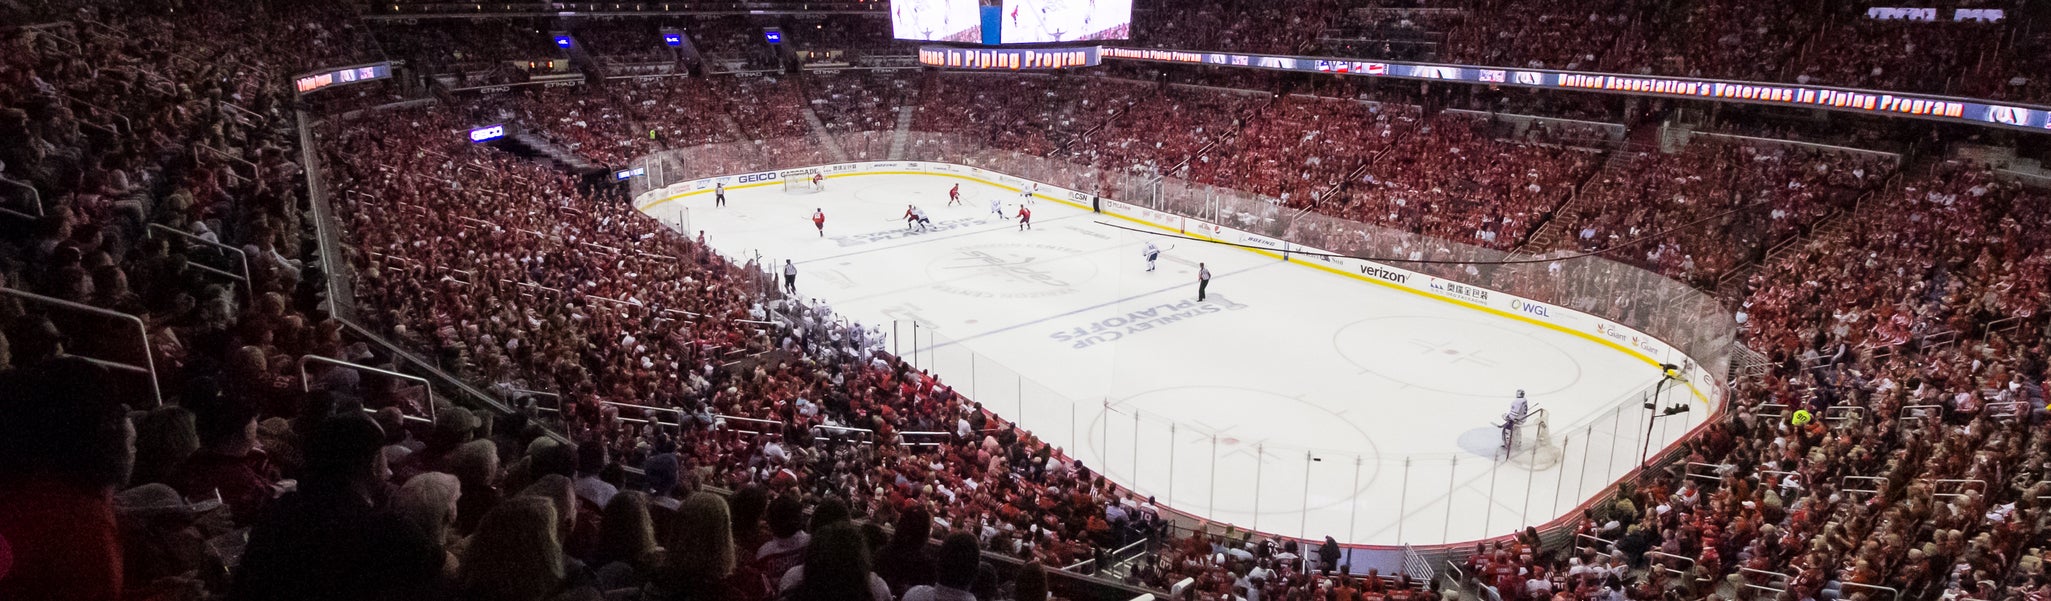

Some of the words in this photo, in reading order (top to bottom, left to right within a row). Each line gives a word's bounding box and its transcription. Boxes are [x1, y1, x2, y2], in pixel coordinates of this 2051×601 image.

[965, 50, 1020, 70] Piping
[1025, 50, 1087, 69] Program
[1558, 73, 1604, 89] United
[1606, 76, 1711, 96] Association's
[1715, 83, 1794, 102] Veterans
[1818, 90, 1877, 110] Piping
[1879, 95, 1964, 118] Program
[471, 126, 502, 141] GEICO
[739, 172, 777, 184] GEICO
[1075, 193, 1088, 201] CSN
[1248, 236, 1275, 247] BOEING
[1360, 264, 1405, 284] verizon
[1127, 303, 1221, 335] STANLEY
[1523, 302, 1550, 318] WGL
[1050, 299, 1194, 342] PLAYOFFS
[1072, 330, 1124, 350] CUP
[1607, 328, 1626, 342] Giant
